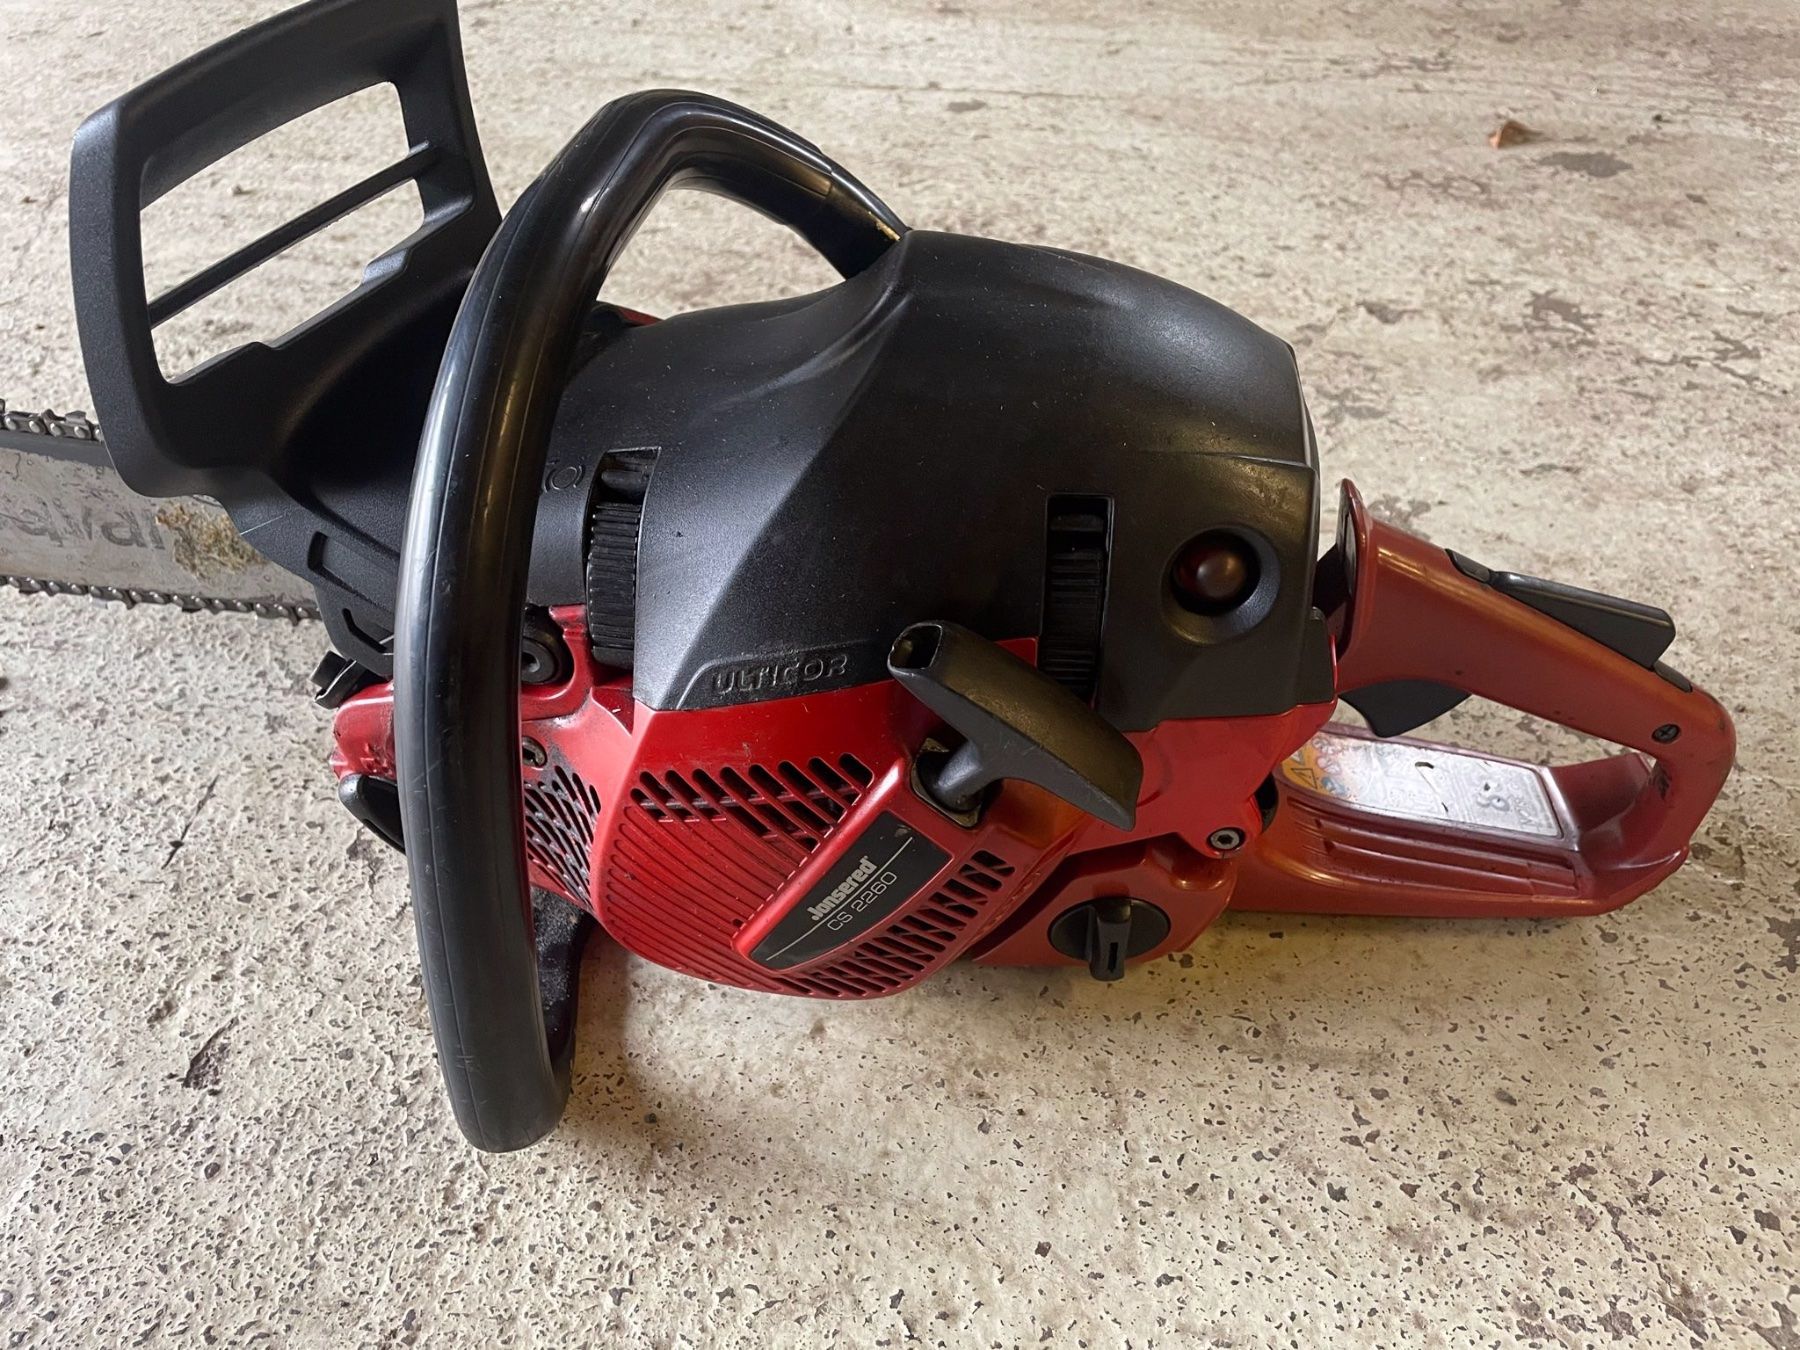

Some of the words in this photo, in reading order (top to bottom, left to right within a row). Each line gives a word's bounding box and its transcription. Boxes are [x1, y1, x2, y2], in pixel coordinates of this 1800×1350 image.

[806, 855, 878, 921] Jonsered
[827, 911, 853, 931] CS
[851, 871, 898, 912] 2260
